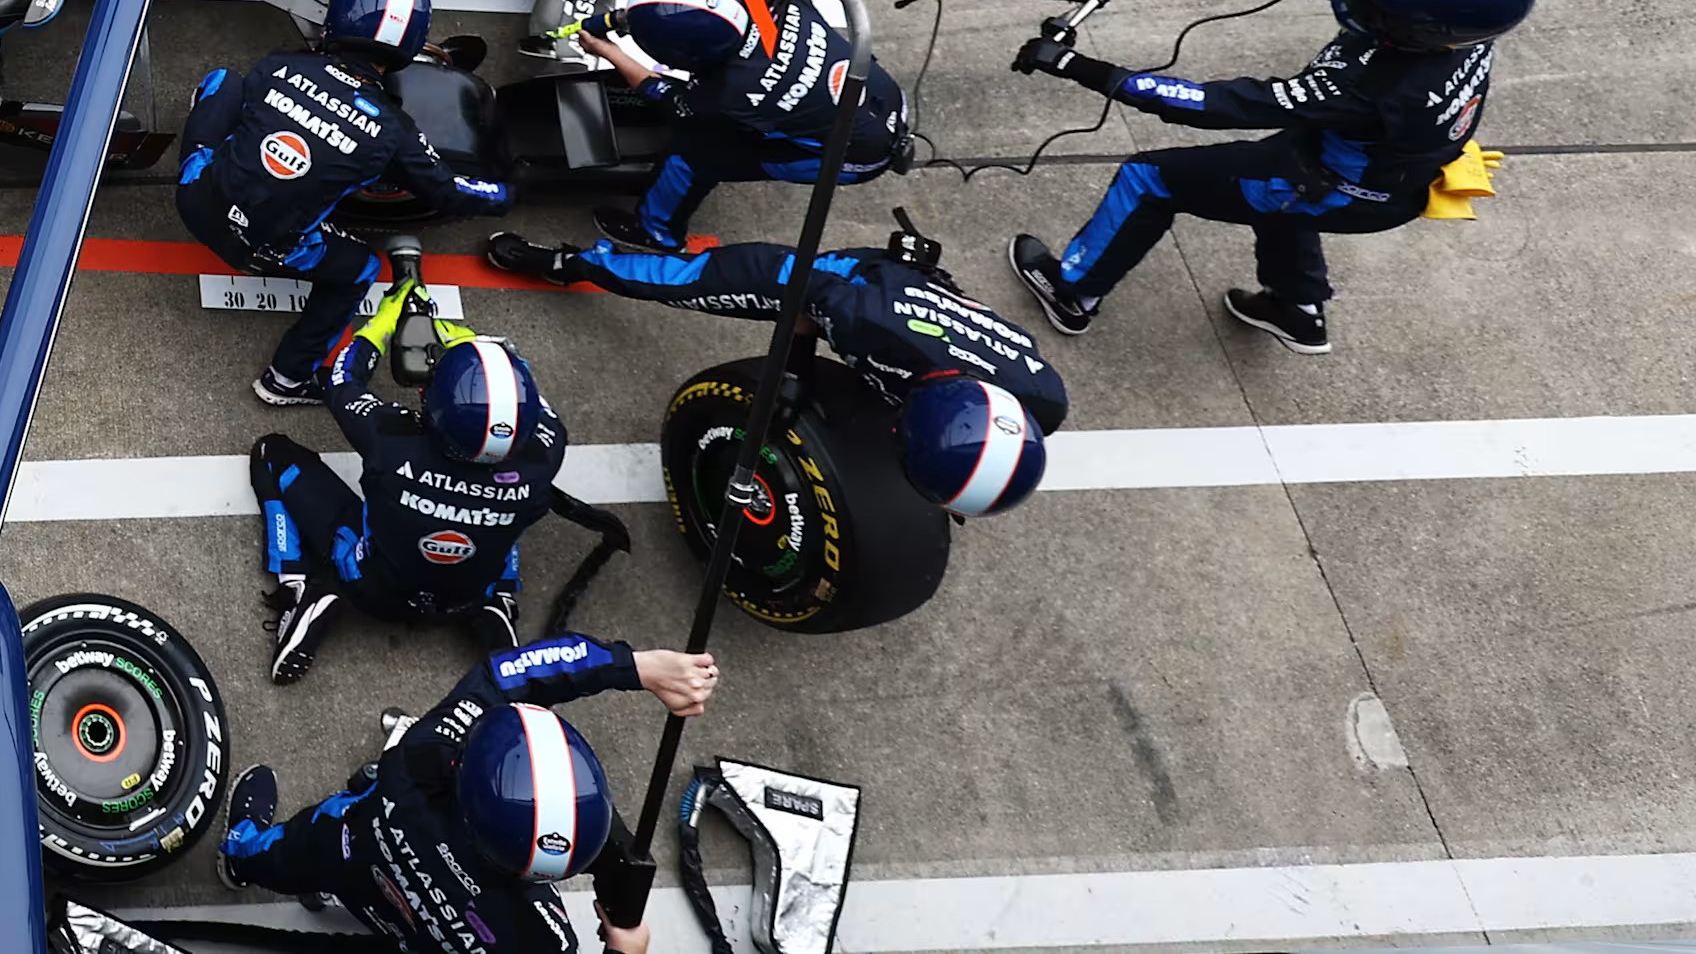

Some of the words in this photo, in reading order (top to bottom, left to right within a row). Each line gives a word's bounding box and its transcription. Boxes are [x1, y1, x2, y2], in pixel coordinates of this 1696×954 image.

[761, 3, 801, 92] ATLASSIAN
[776, 21, 828, 112] KOMATSU
[1444, 43, 1486, 96] ATLASS
[324, 64, 362, 89] sparco
[1135, 76, 1205, 103] KOATSU
[263, 88, 358, 155] KOMATSU
[287, 73, 382, 138] ATLASSIAN
[265, 139, 306, 172] Gulf
[1336, 181, 1391, 203] sparco
[224, 292, 245, 309] 30
[256, 293, 277, 310] 20
[288, 294, 307, 311] 10
[904, 286, 1033, 349] KOMATSU
[893, 300, 1020, 361] ATLASSIAN
[399, 489, 515, 527] KOMATSU
[417, 470, 531, 501] ATLASSIAN
[276, 512, 287, 552] sparco
[784, 492, 805, 552] betway
[798, 456, 840, 572] ZERO
[422, 539, 473, 559] Gulf
[55, 649, 115, 675] betway
[115, 655, 163, 700] SCORES
[499, 641, 587, 680] KOMATSU
[188, 676, 213, 703] P
[33, 750, 78, 808] betway
[151, 729, 176, 793] betway
[184, 710, 223, 830] ZERO
[101, 788, 154, 814] SCORES
[771, 791, 821, 817] SPARE
[436, 842, 481, 896] sparco
